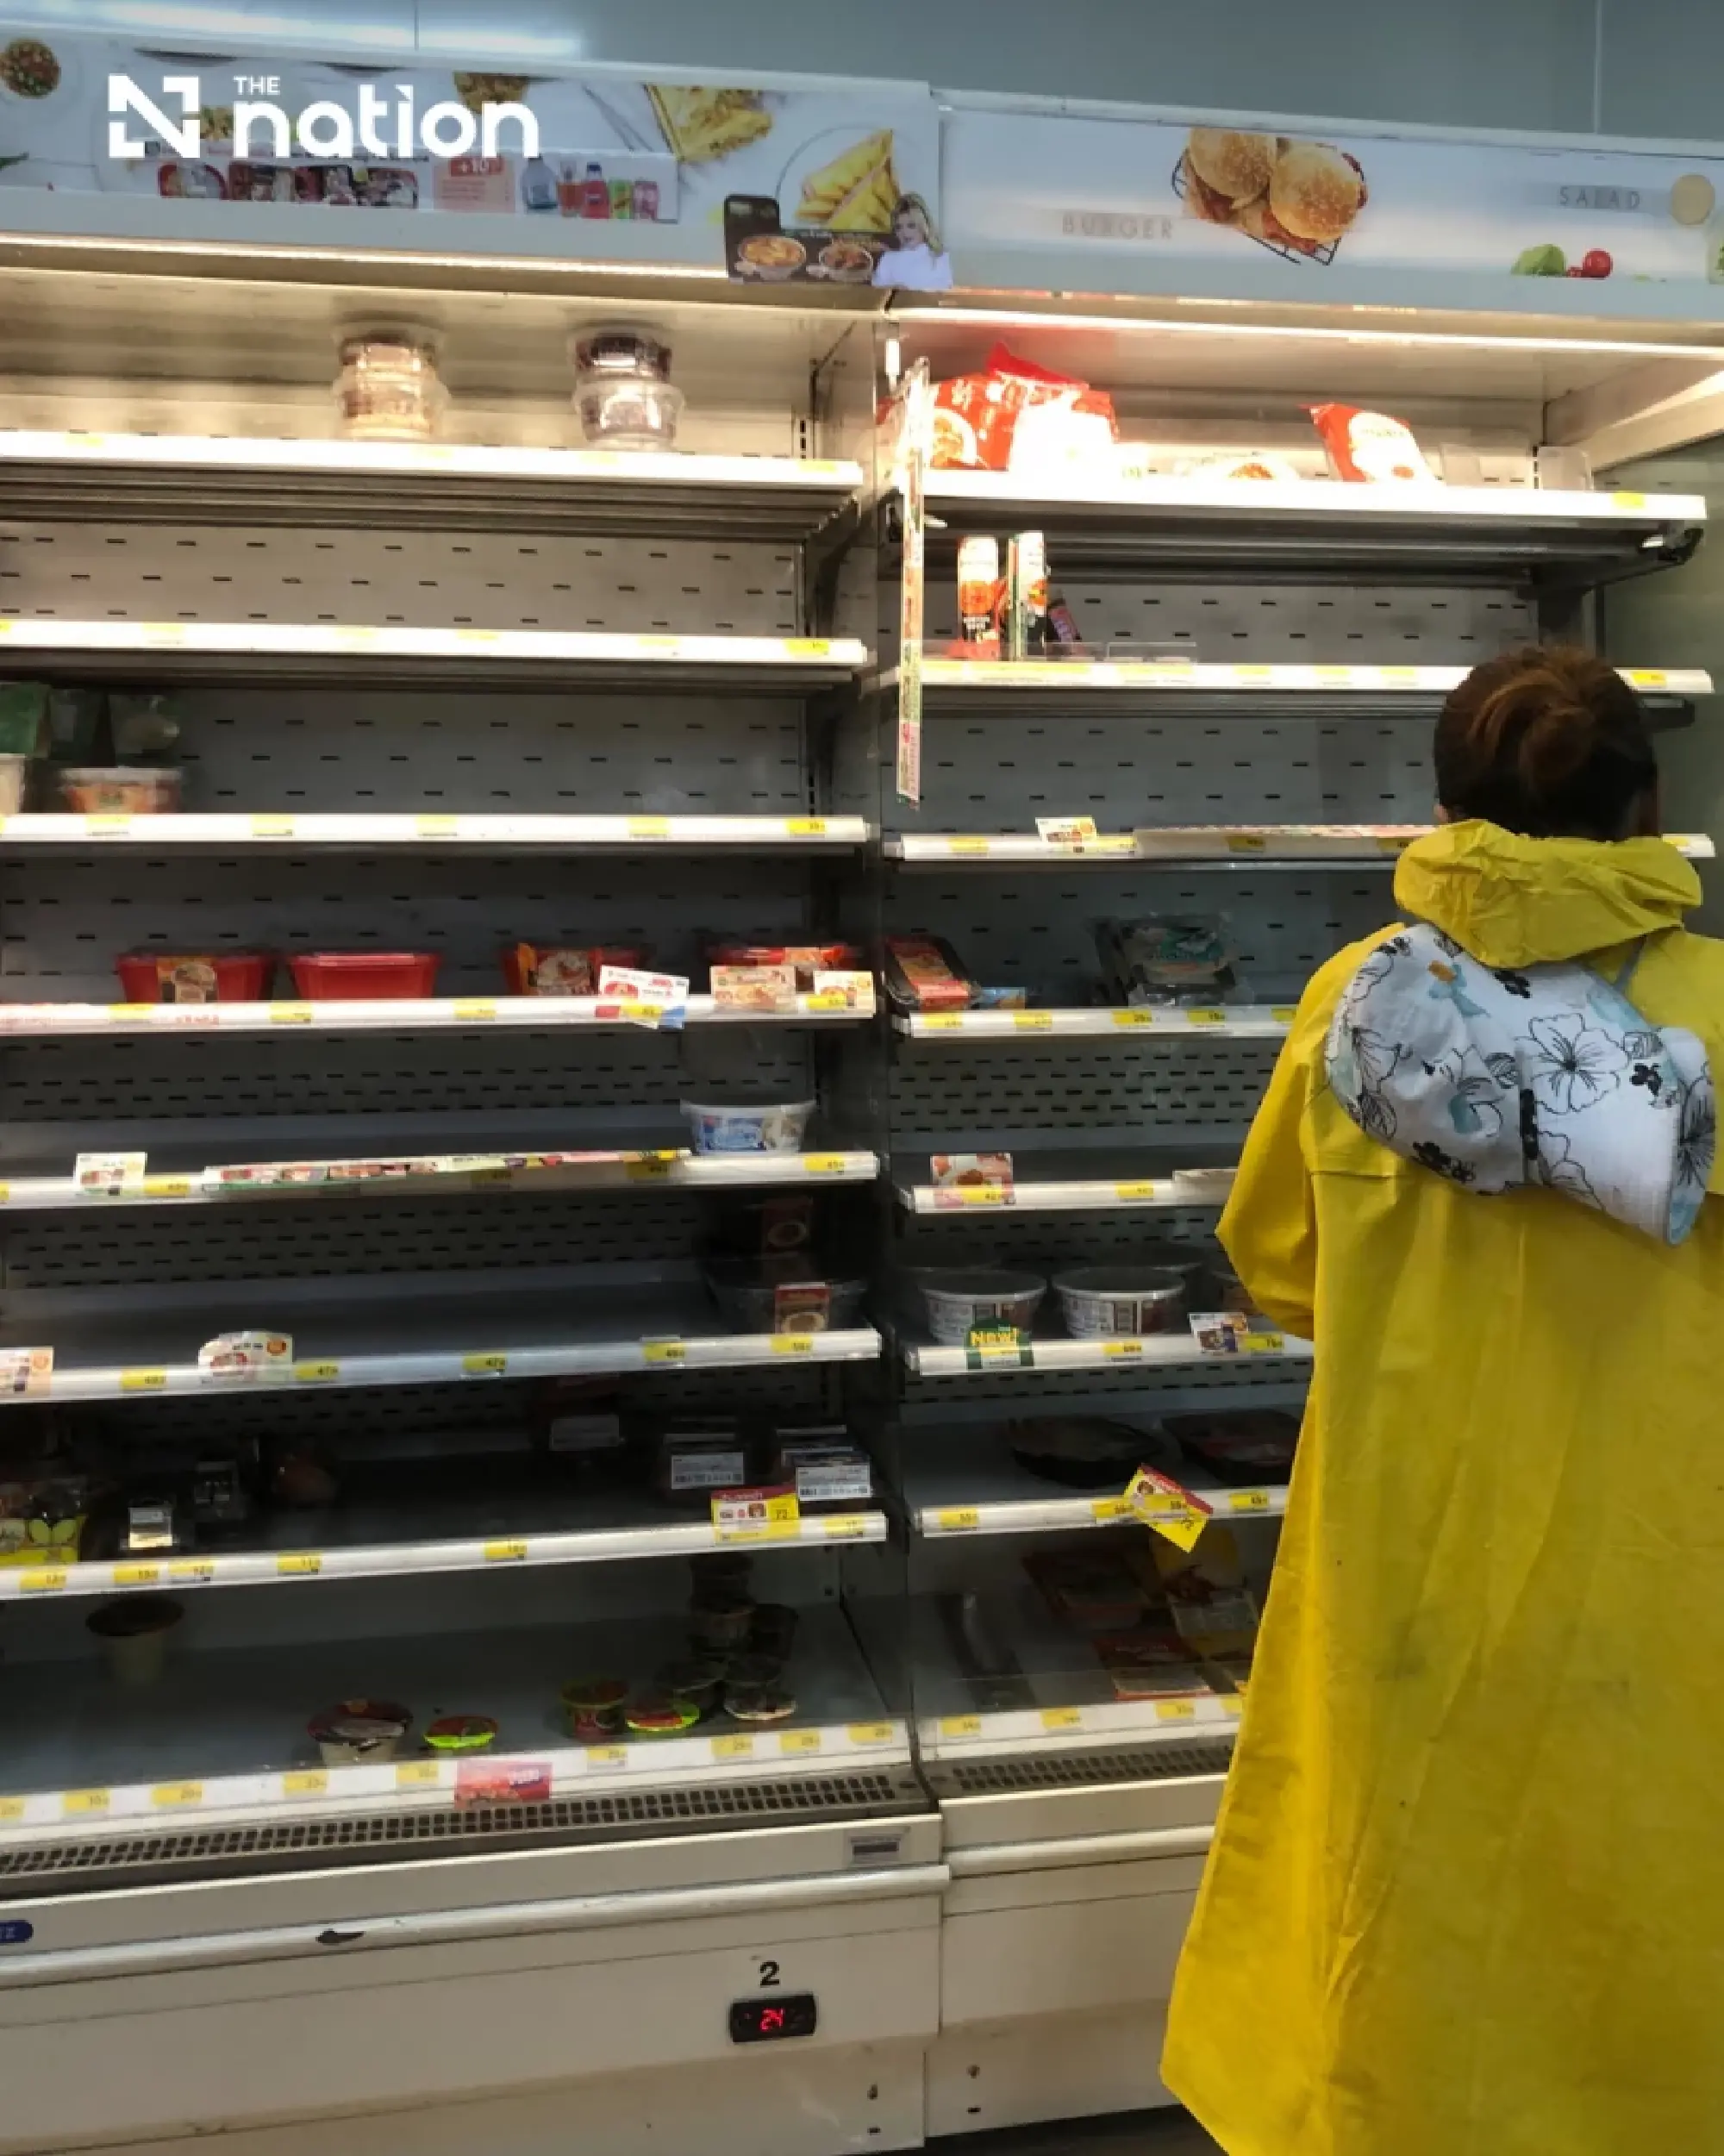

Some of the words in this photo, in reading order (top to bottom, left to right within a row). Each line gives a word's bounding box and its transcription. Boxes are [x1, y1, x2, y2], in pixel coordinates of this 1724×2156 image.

[1559, 185, 1642, 209] SALAD
[1062, 214, 1173, 240] BURGER
[759, 1960, 781, 1988] 2
